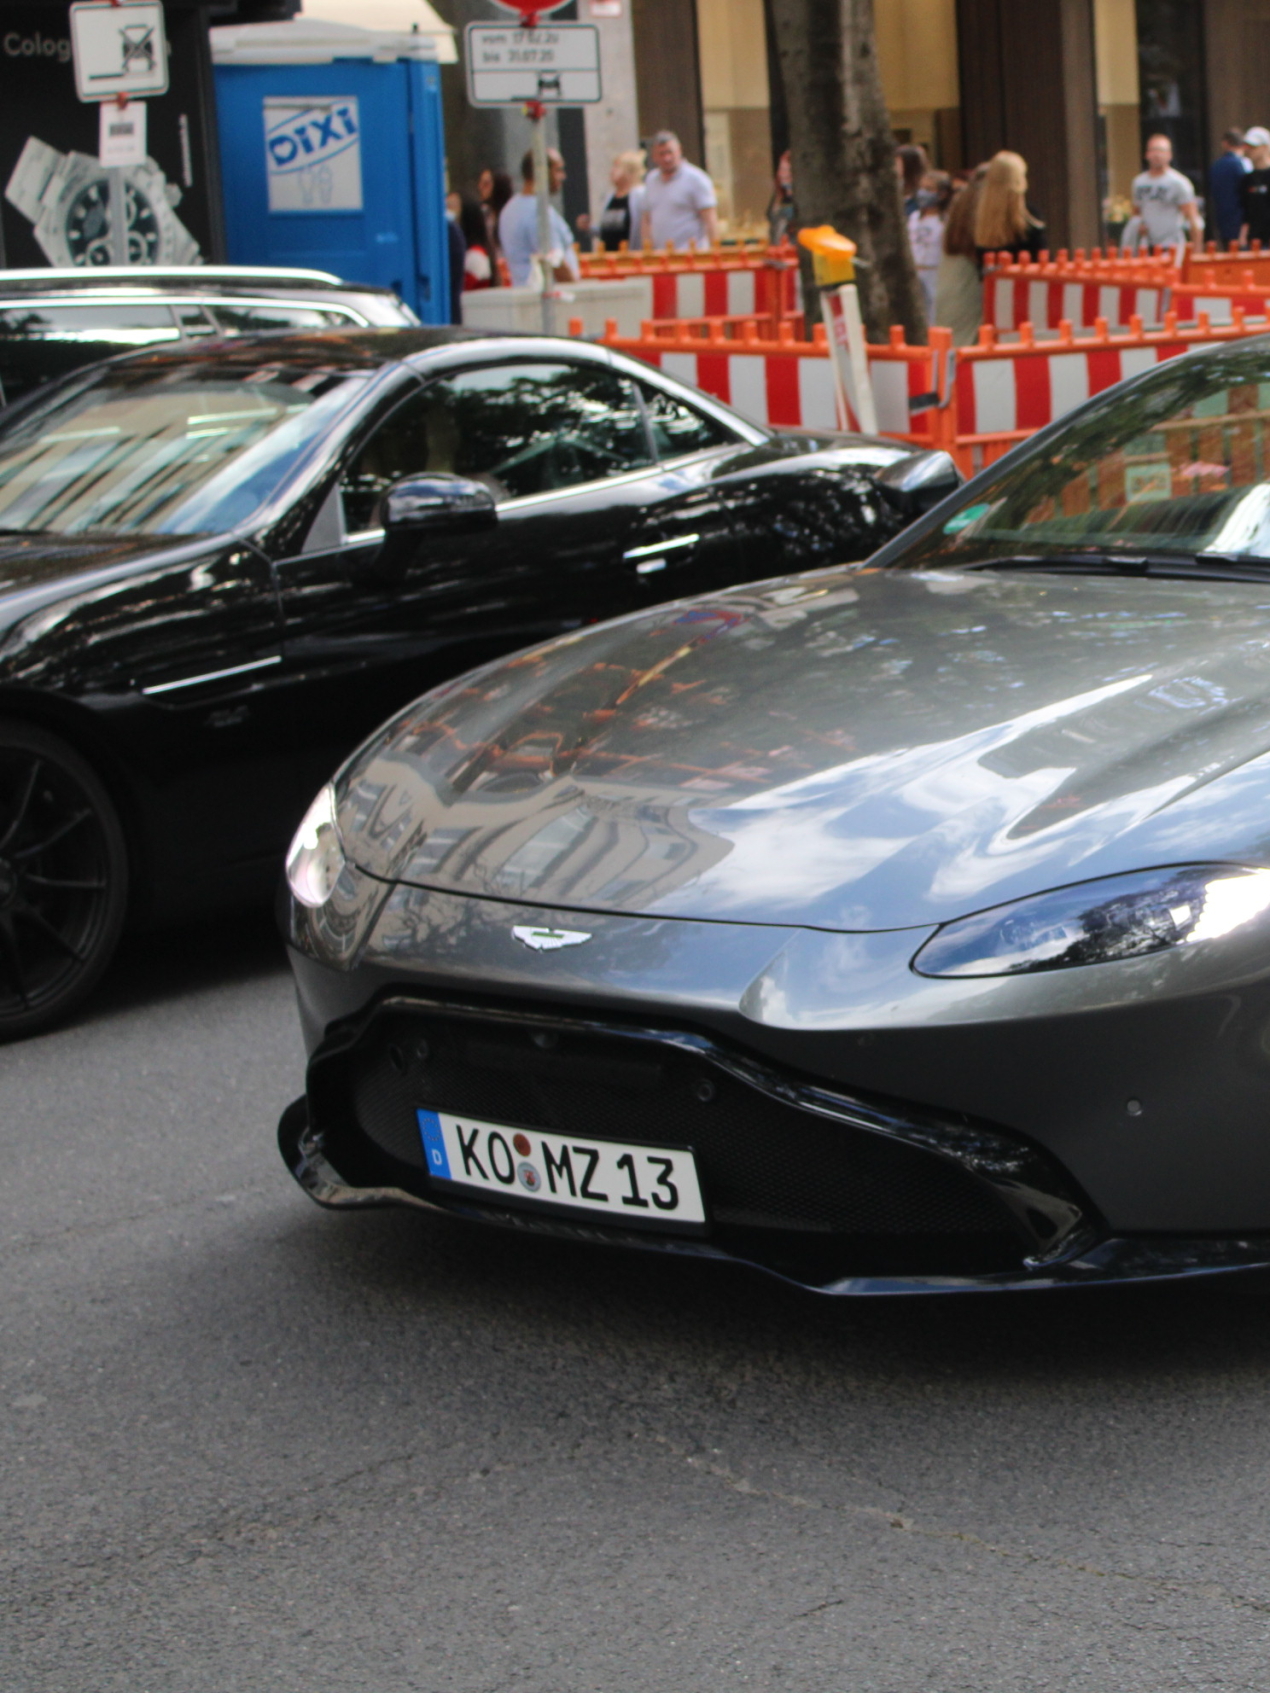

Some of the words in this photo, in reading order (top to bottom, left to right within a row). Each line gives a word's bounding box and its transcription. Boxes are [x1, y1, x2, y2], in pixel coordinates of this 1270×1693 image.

[4, 31, 71, 62] Colog
[432, 1148, 443, 1166] D
[456, 1124, 516, 1185] KO
[541, 1141, 609, 1202] MZ
[616, 1153, 680, 1211] 13
